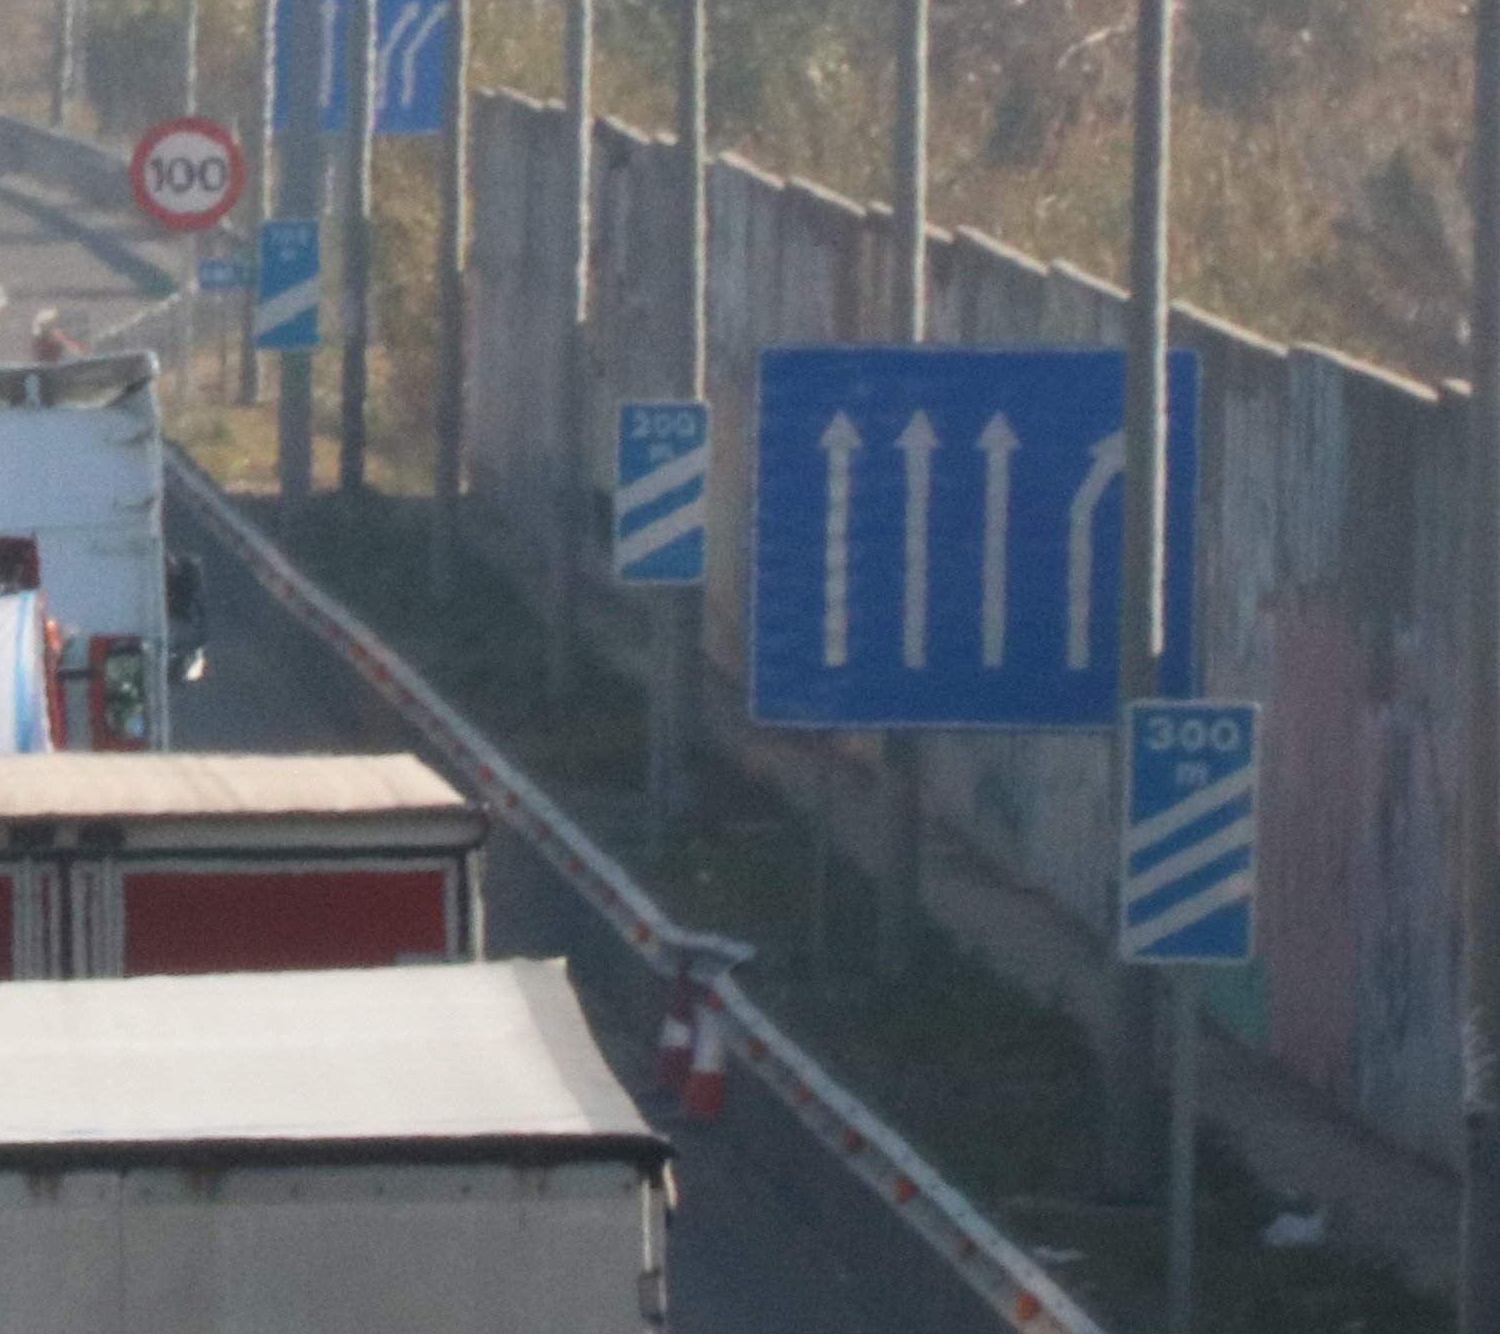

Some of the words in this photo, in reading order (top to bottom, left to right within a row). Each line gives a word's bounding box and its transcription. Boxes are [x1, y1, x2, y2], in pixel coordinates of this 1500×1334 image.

[146, 152, 226, 192] 100
[630, 414, 697, 440] 200
[1144, 716, 1238, 751] 300
[1174, 761, 1209, 785] m
